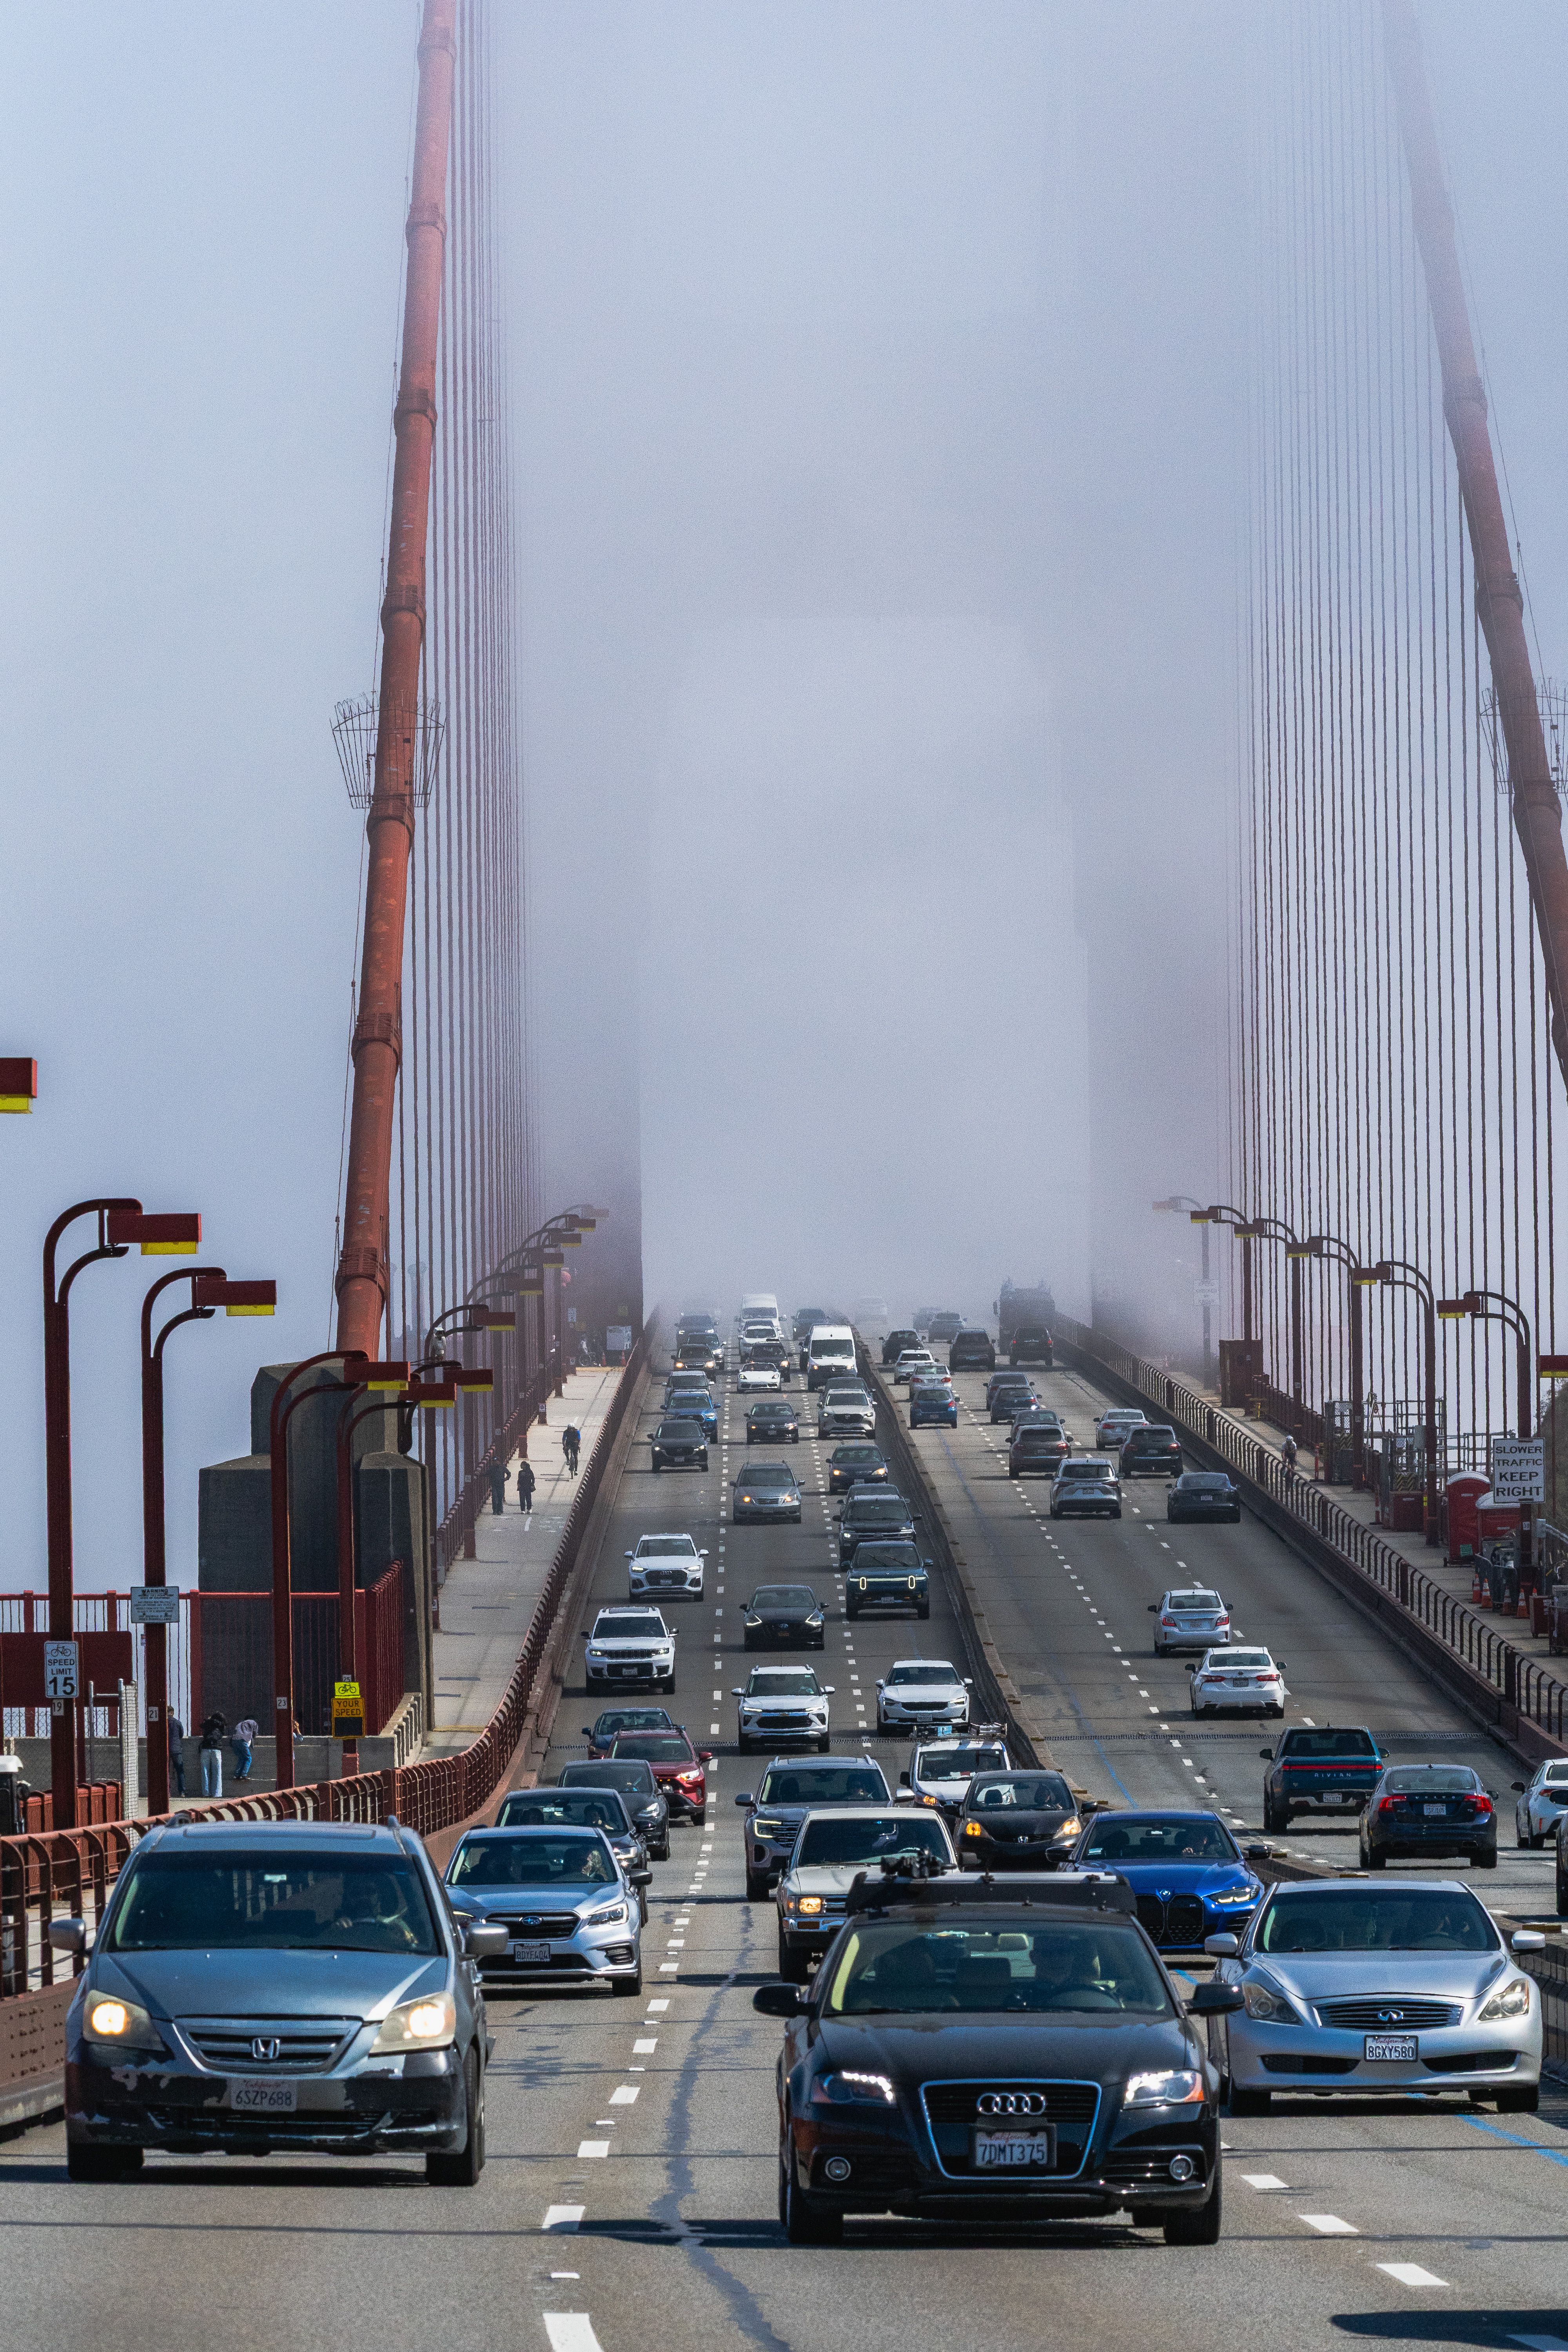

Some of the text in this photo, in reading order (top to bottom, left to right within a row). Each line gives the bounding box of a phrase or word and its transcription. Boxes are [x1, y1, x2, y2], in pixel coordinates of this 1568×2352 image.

[1499, 1472, 1539, 1482] KEEP
[1496, 1486, 1543, 1497] RIGHT
[49, 1677, 75, 1695] 15
[53, 1702, 62, 1712] 19
[149, 1710, 157, 1719] 21
[516, 1951, 548, 1959] 8DYF404
[1368, 2045, 1414, 2058] 8GXY580
[236, 2091, 292, 2107] 6SZP688
[979, 2144, 1045, 2162] 7DMT375
